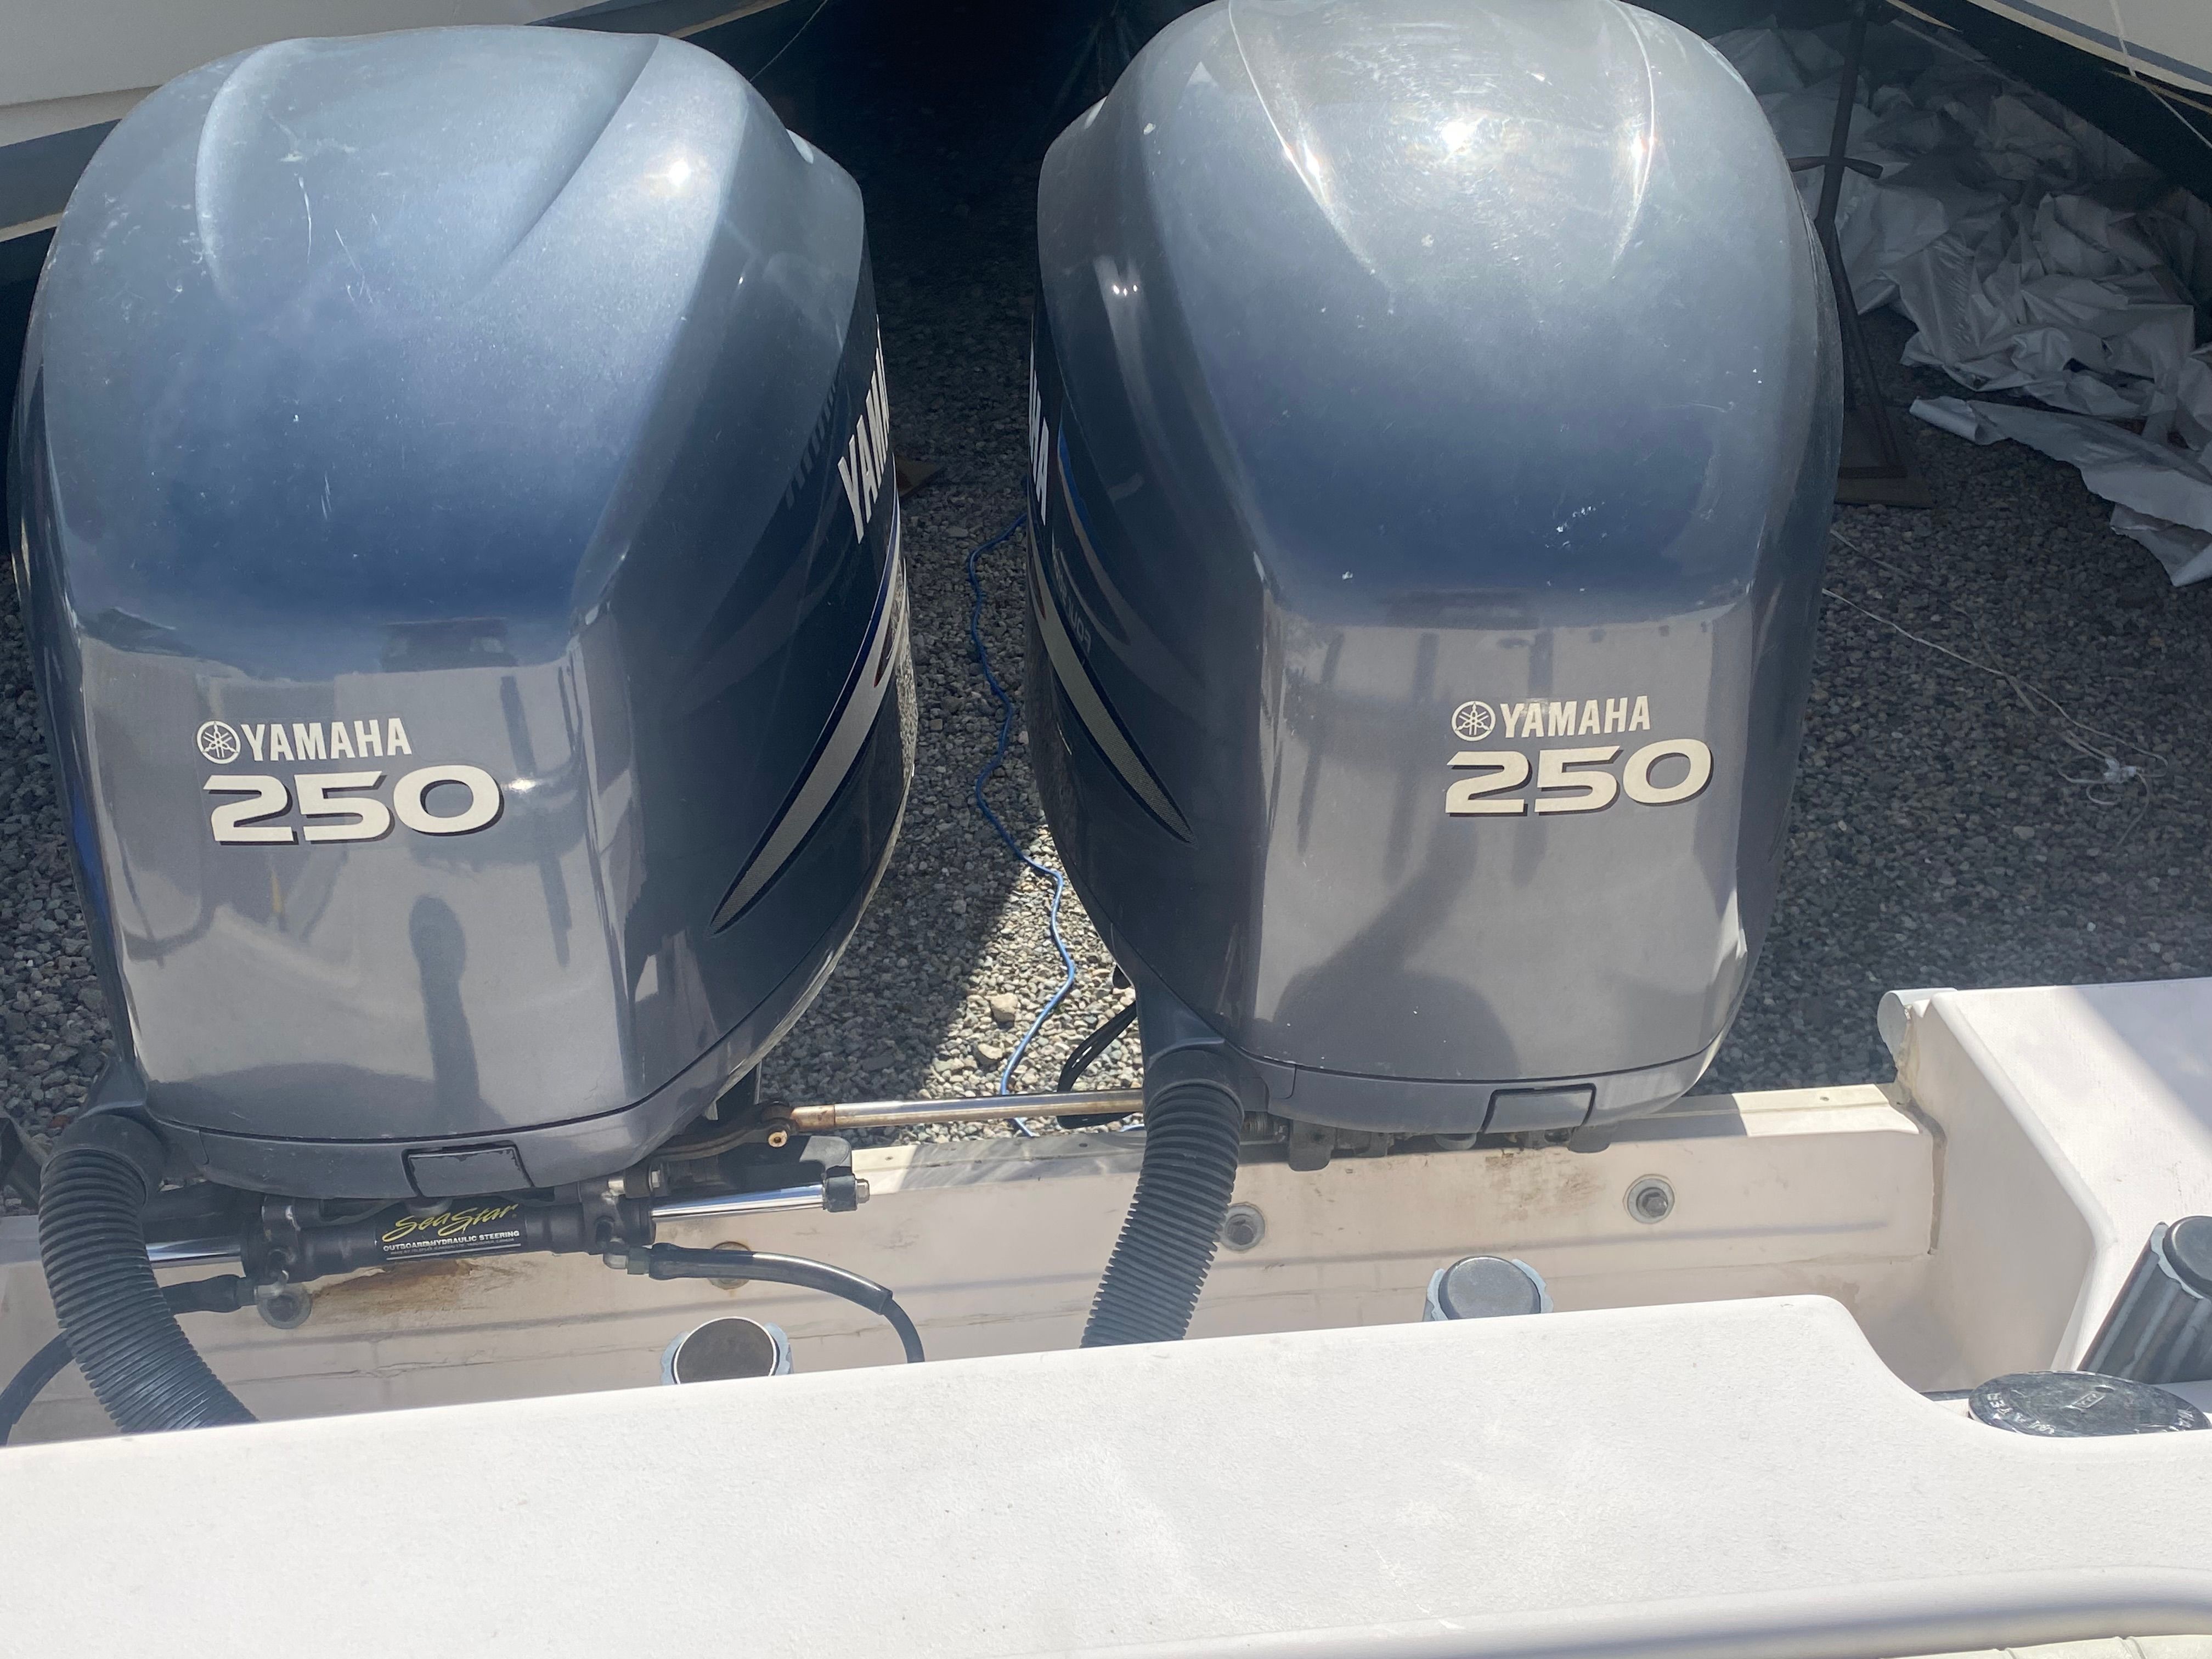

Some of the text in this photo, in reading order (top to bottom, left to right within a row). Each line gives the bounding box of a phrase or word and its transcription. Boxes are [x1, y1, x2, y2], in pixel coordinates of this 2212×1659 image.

[1500, 696, 1651, 738] YAMAHA
[240, 718, 413, 761] YAMAHA
[1445, 738, 1713, 816] 250
[202, 765, 504, 845] 250
[382, 1204, 518, 1242] SeaStar
[382, 1241, 430, 1252] OUTBOARD
[430, 1235, 477, 1246] HYDRAULIC
[479, 1231, 520, 1241] STEERING
